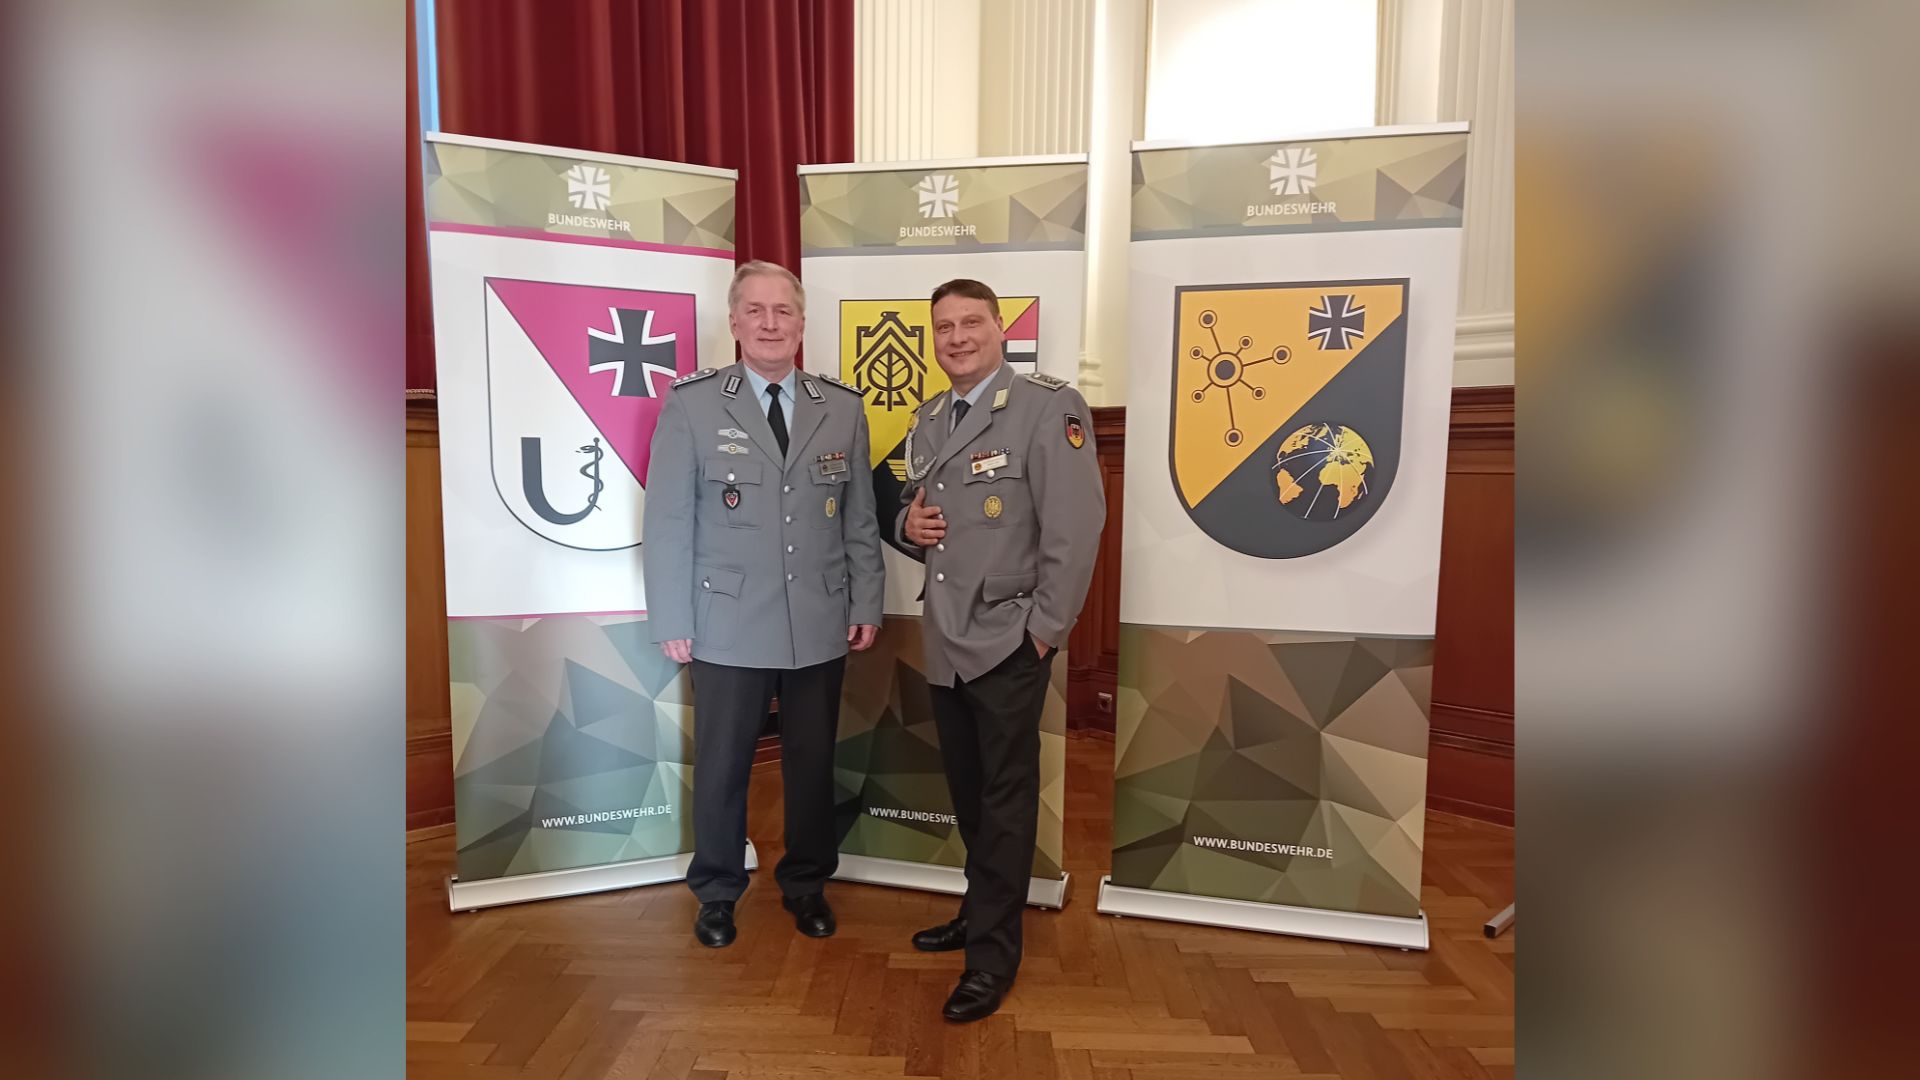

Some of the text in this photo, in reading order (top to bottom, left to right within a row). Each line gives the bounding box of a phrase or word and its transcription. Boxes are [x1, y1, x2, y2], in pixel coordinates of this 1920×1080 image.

[1246, 201, 1337, 217] BUNDESWEHR
[547, 212, 631, 232] BUNDESWEHR
[899, 224, 977, 237] BUNDESWEHR
[541, 804, 672, 828] WWW.BUNDESWEHR.DE
[869, 806, 958, 825] WWW.BUNDESWE
[1193, 835, 1334, 859] WWW.BUNDESWEHR.DE
